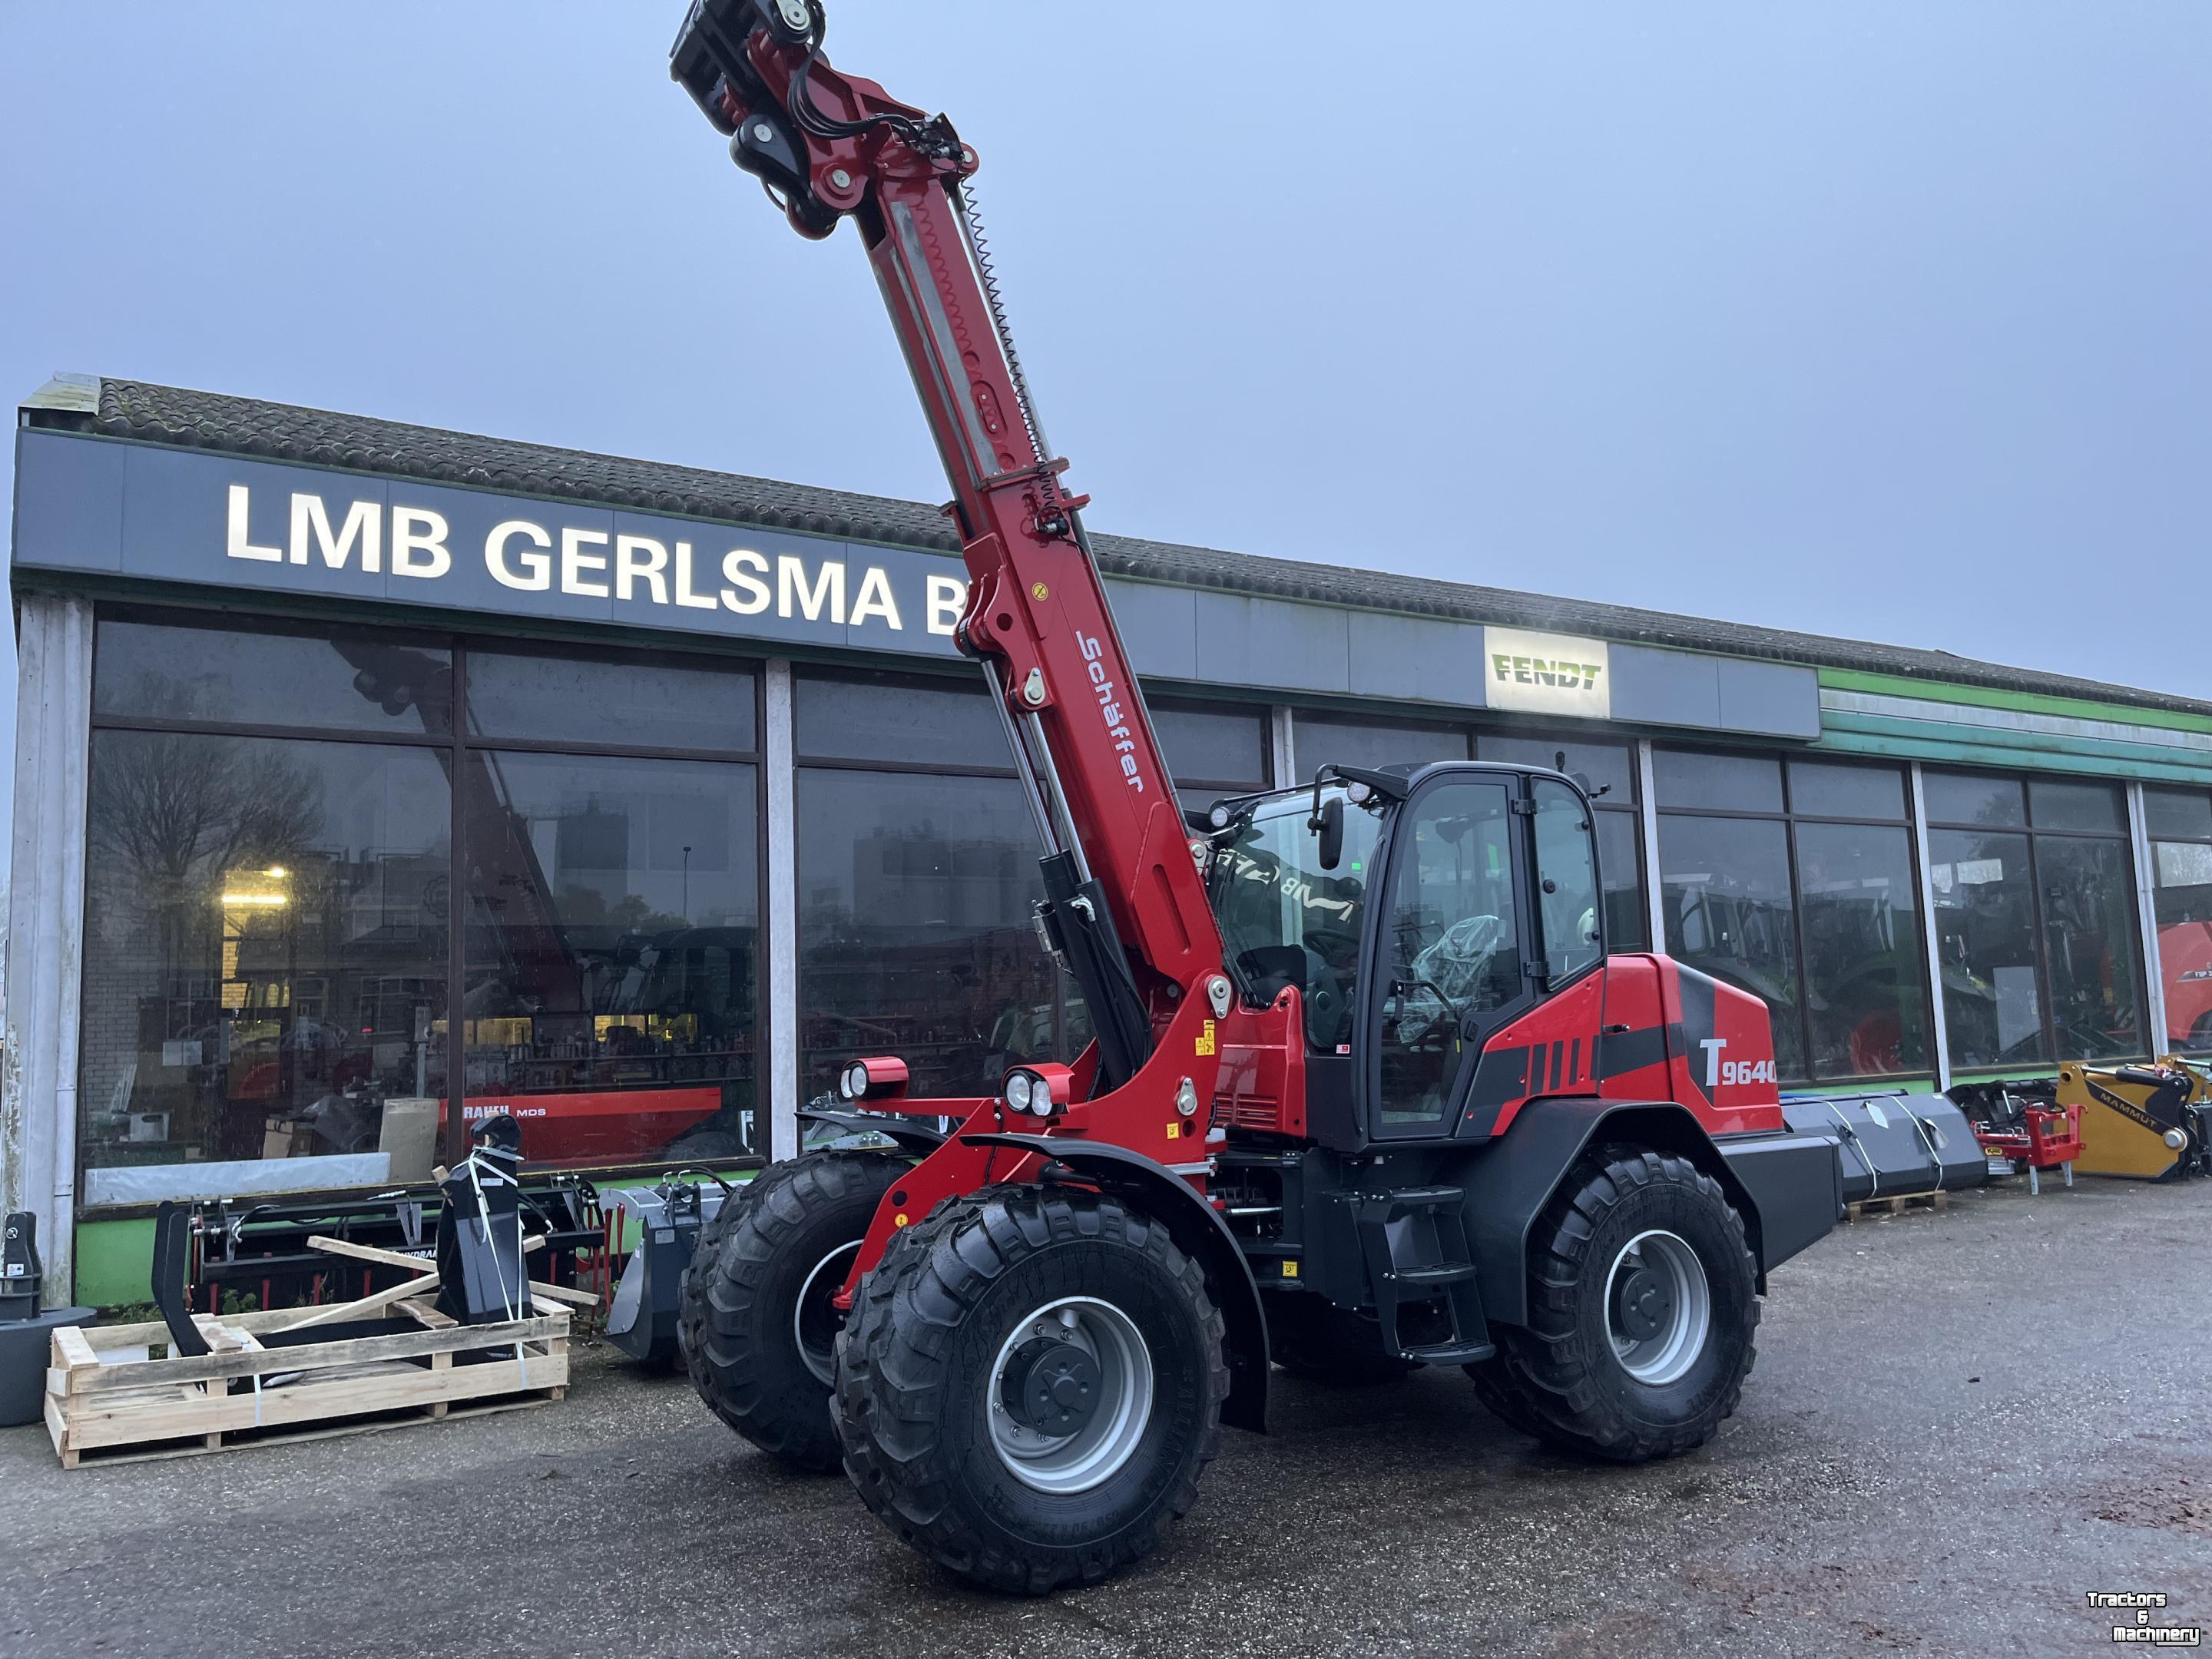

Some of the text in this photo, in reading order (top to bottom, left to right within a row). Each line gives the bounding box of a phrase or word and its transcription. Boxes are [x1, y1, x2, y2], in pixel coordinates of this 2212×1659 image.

[227, 485, 452, 578] LMB
[484, 520, 902, 631] GERLSMA
[1492, 654, 1602, 690] FENDT
[1075, 631, 1144, 793] Schäffer
[516, 1108, 547, 1118] MDS
[2100, 1092, 2157, 1128] MAMMUT
